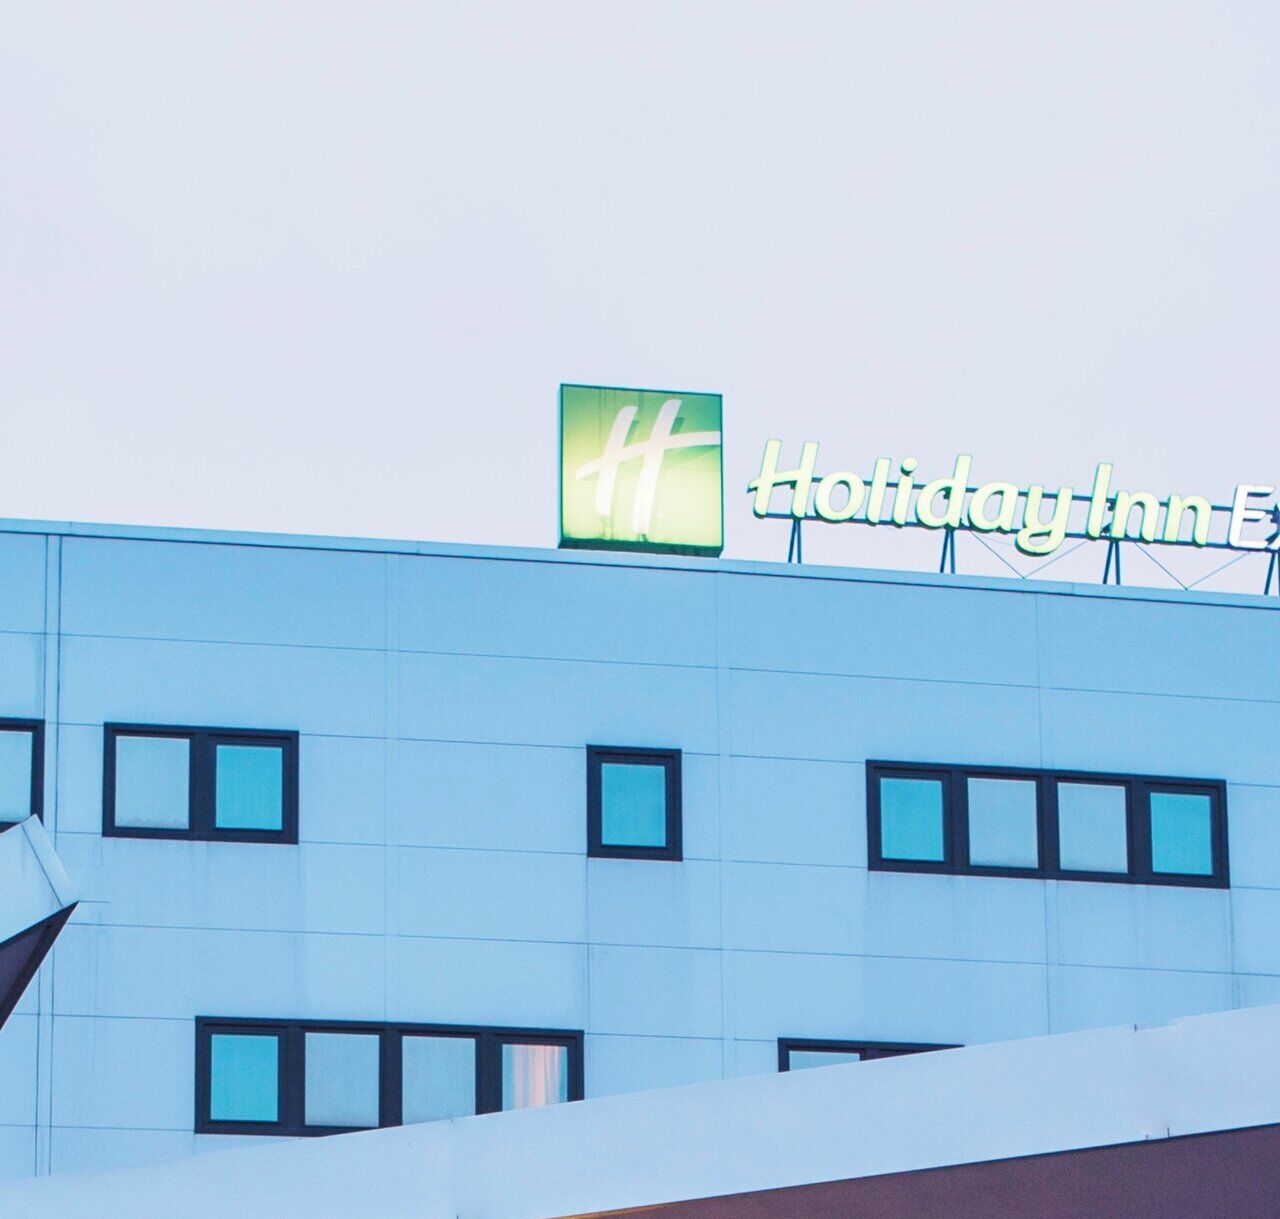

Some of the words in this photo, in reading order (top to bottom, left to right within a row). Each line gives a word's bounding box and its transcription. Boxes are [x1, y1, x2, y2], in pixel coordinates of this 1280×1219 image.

[575, 398, 721, 534] H
[747, 439, 1074, 557] Holiday
[1086, 462, 1212, 547] Inn
